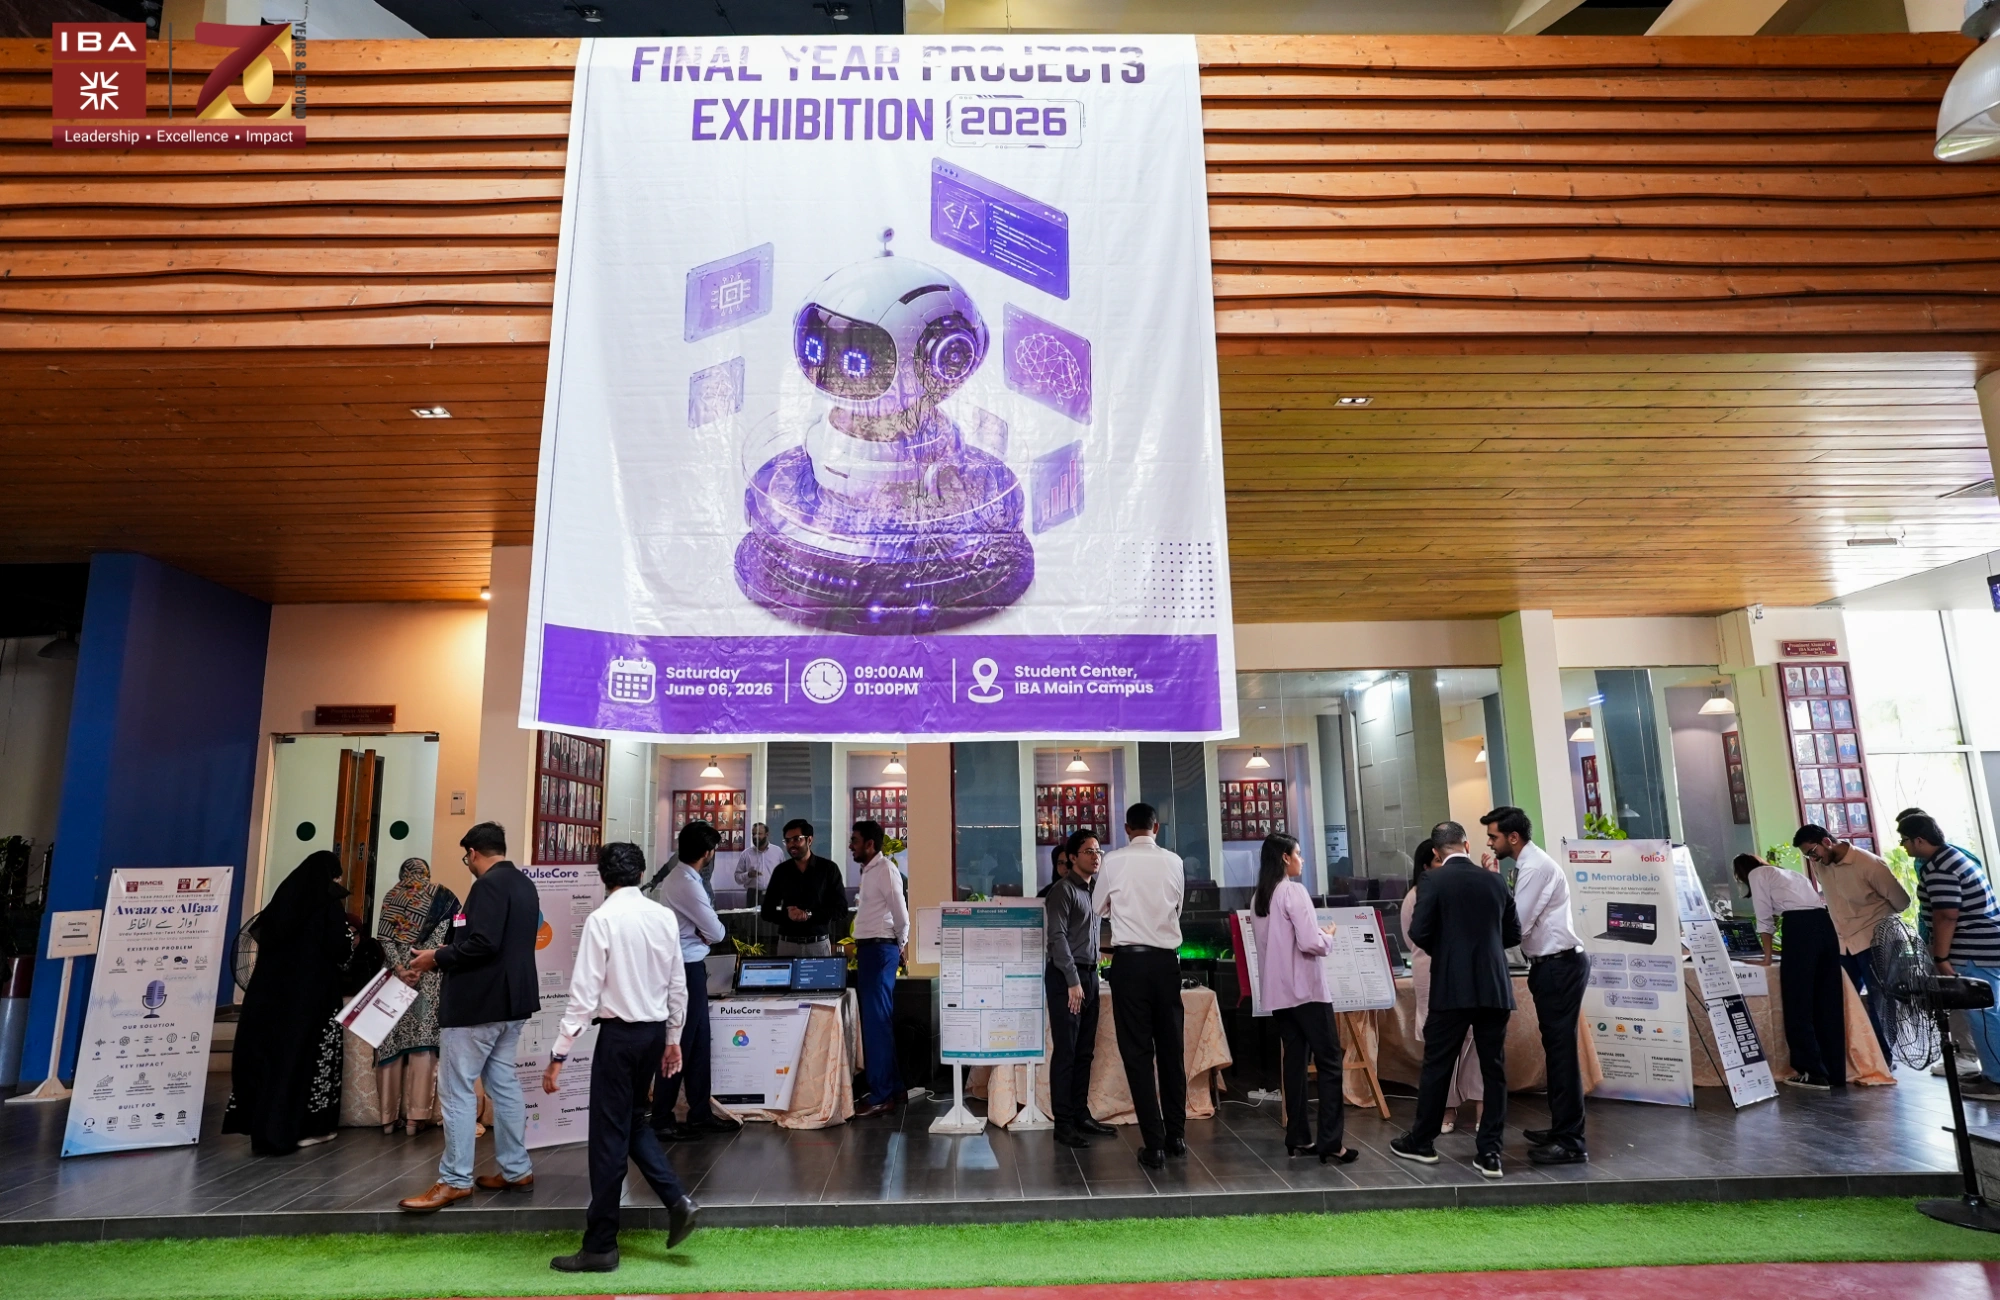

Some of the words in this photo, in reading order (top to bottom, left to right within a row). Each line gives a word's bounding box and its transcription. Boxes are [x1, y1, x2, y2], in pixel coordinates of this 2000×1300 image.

[631, 45, 763, 82] FINAL
[780, 45, 900, 81] YEAR
[922, 45, 1146, 84] PROJECTS
[691, 98, 933, 141] EXHIBITION
[960, 106, 1067, 136] 2026
[666, 666, 741, 684] Saturday
[854, 666, 924, 679] 09:00AM
[1014, 665, 1077, 678] Student
[1079, 665, 1138, 680] Center,
[665, 683, 705, 696] June
[708, 683, 732, 698] 06,
[735, 683, 773, 696] 2026
[854, 682, 919, 695] 01:00PM
[1015, 682, 1041, 694] IBA
[1044, 680, 1084, 694] Main
[1086, 681, 1154, 698] Campus
[1640, 854, 1666, 863] folio3
[521, 868, 579, 879] PulseCore
[1591, 873, 1660, 882] Memorable.io
[113, 905, 158, 915] Awaaz
[160, 905, 175, 914] se
[176, 902, 219, 914] Alfaaz
[126, 918, 152, 930] الفاظ
[155, 919, 173, 929] سے
[177, 912, 201, 929] آواز
[720, 1006, 761, 1015] PulseCore
